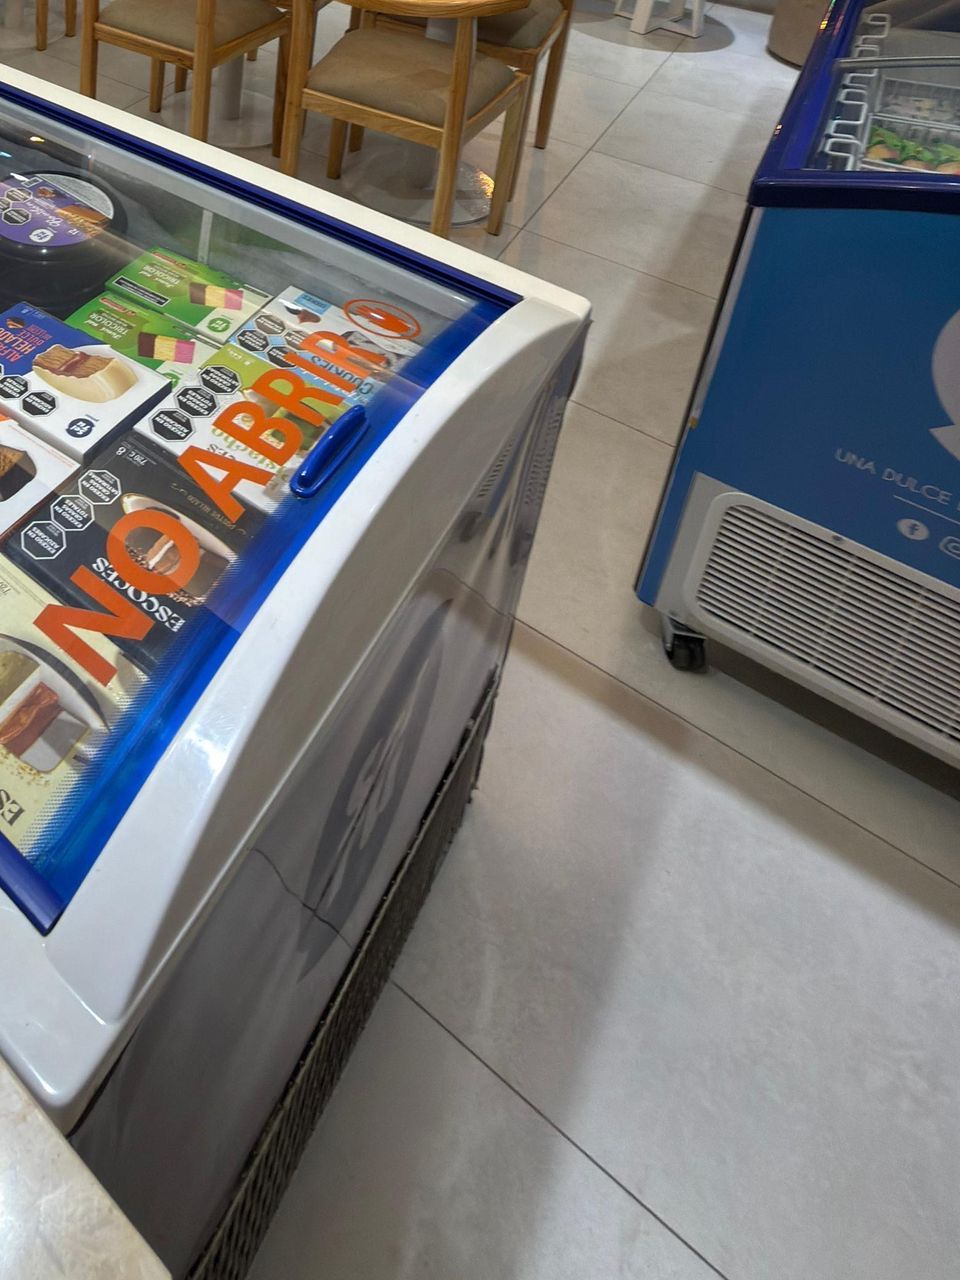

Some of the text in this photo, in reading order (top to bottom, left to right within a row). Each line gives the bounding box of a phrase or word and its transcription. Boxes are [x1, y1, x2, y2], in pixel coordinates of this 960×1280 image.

[115, 444, 126, 457] 8
[88, 476, 110, 497] GRASAS
[834, 448, 952, 505] UNA DULCE
[80, 478, 110, 502] EXCESO EN
[33, 330, 387, 686] NO ABRIR
[53, 503, 83, 529] EXCESO EN
[60, 501, 83, 522] GRASAS
[63, 497, 89, 520] TOTALES
[26, 528, 37, 538] EN
[34, 534, 56, 554] EXCESO
